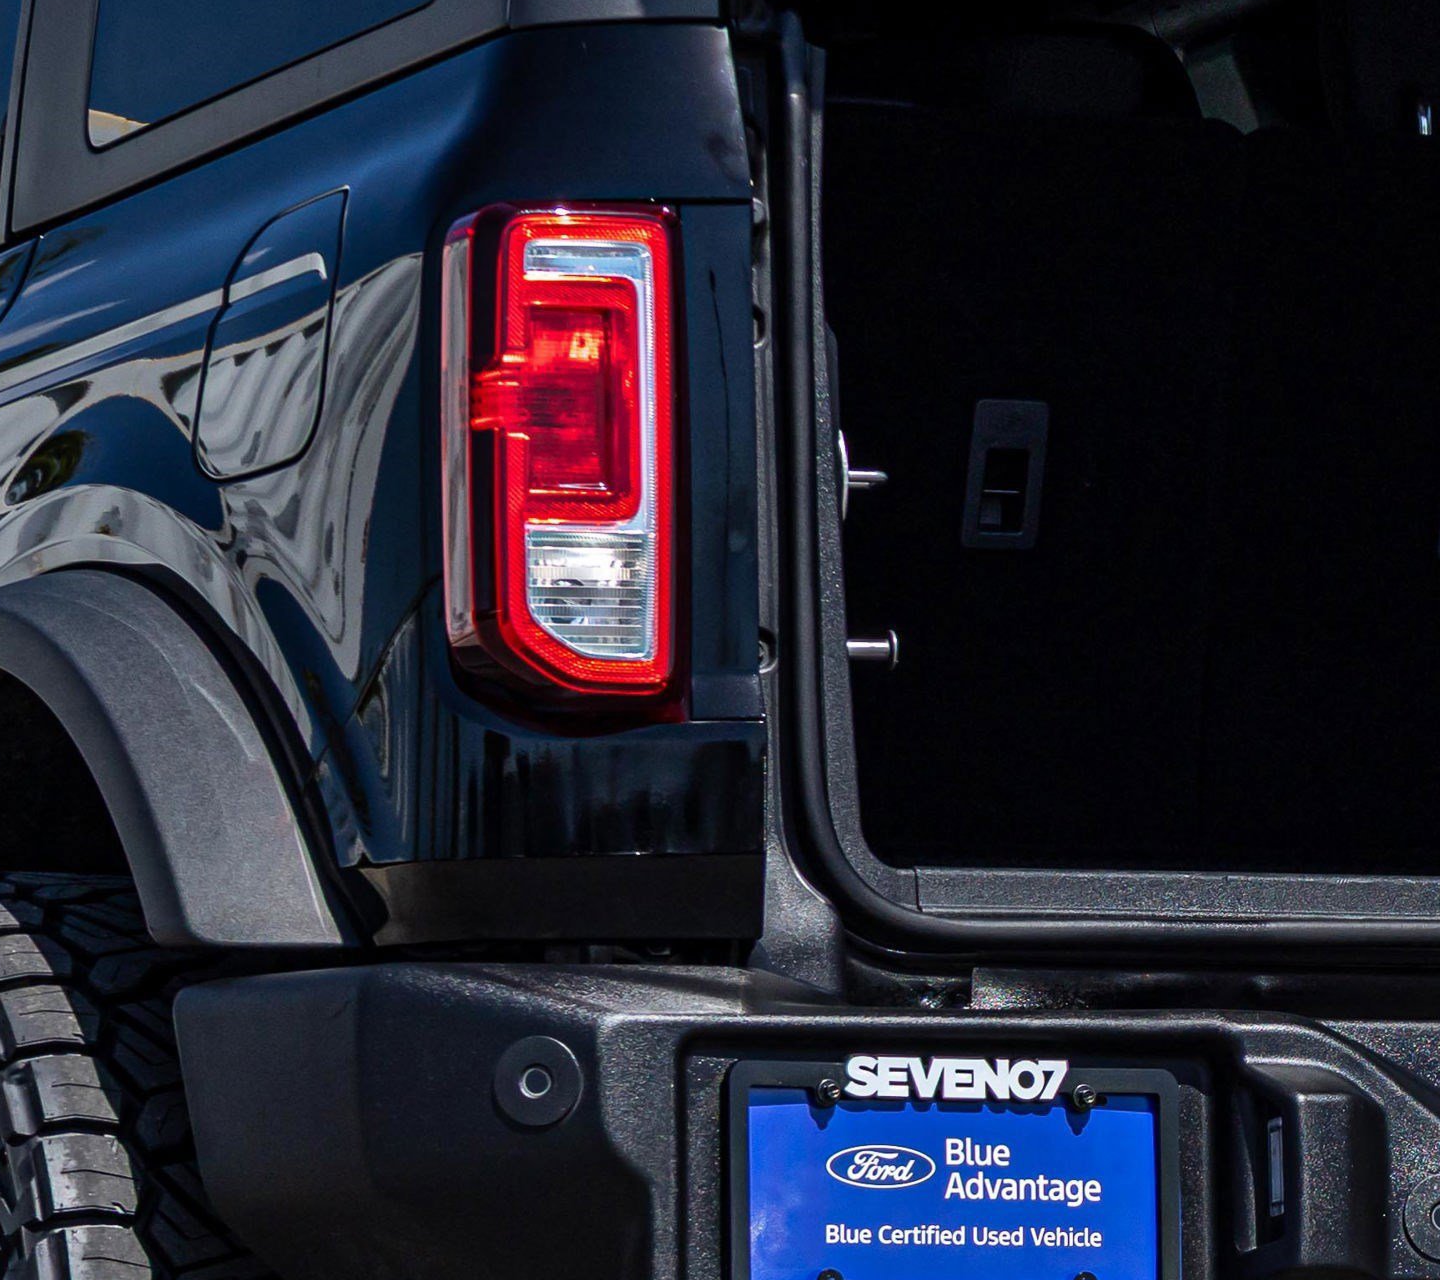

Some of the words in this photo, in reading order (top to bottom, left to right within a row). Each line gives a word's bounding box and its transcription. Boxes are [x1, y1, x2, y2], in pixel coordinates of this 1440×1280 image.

[845, 1150, 914, 1182] Ford
[945, 1138, 1010, 1167] Blue
[944, 1172, 1101, 1207] Advantage
[826, 1224, 872, 1244] Blue
[879, 1225, 966, 1246] Certified
[973, 1227, 1024, 1246] Used
[1031, 1227, 1103, 1248] Vehicle
